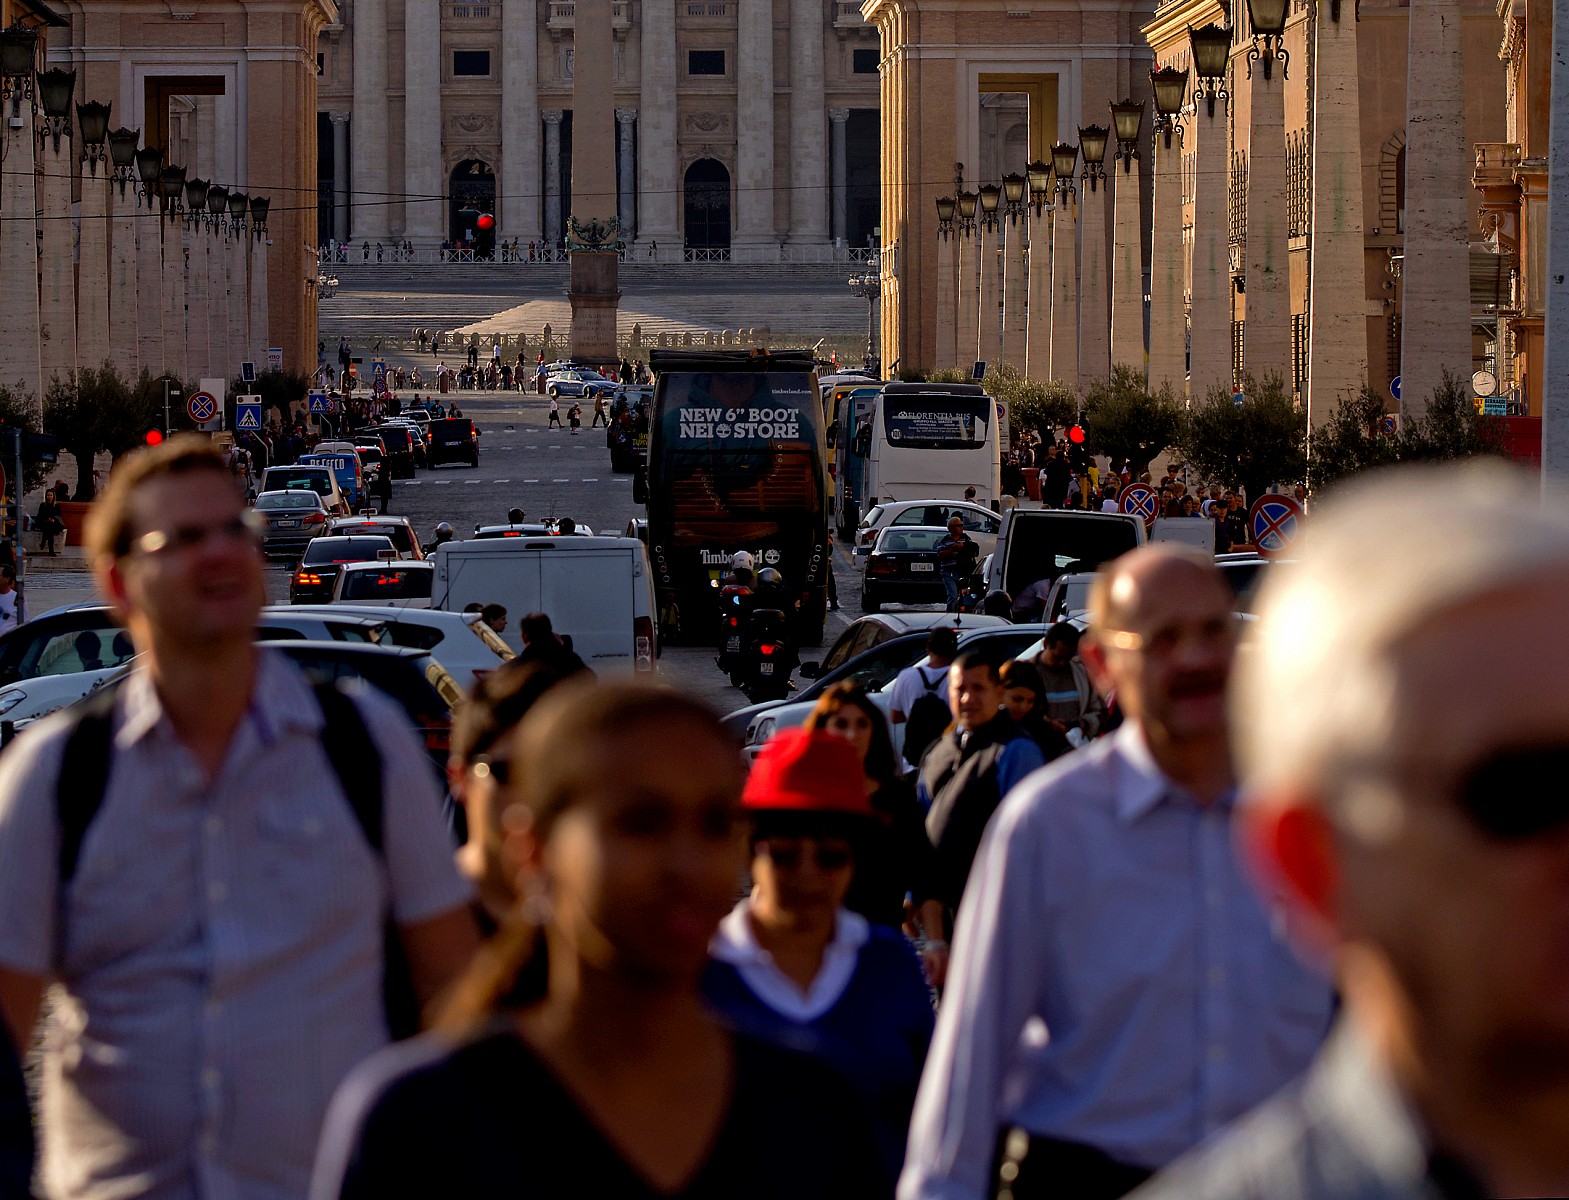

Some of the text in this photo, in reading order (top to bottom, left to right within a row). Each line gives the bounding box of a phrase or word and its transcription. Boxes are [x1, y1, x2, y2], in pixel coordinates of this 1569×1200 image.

[680, 409, 723, 422] NEW
[748, 408, 799, 422] BOOT
[908, 412, 953, 420] FLORENTIA
[680, 423, 799, 439] NEI STORE
